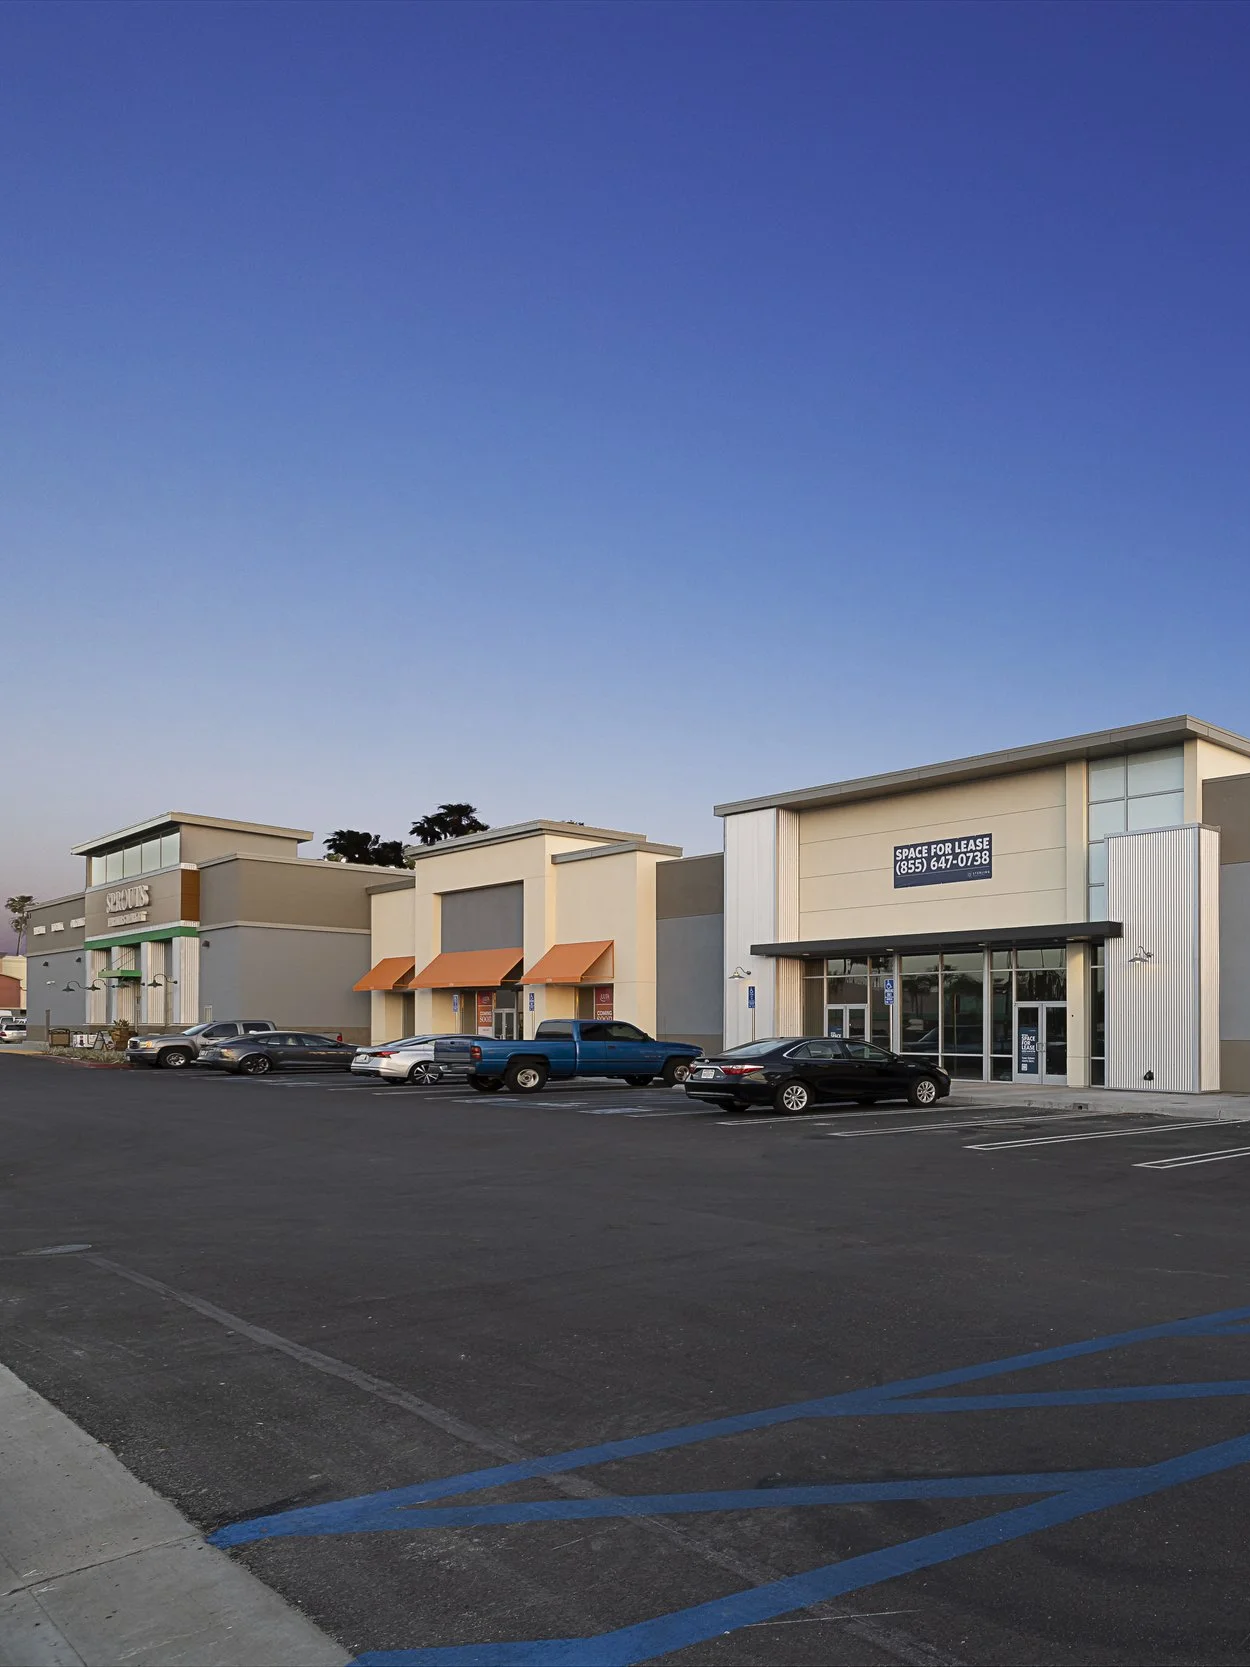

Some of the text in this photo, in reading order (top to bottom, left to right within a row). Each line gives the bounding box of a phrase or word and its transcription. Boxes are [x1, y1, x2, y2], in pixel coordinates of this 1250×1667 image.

[896, 837, 990, 861] SPACE FOR LEASE
[896, 851, 990, 876] (855) 647-0738
[106, 884, 150, 914] SPROUTS
